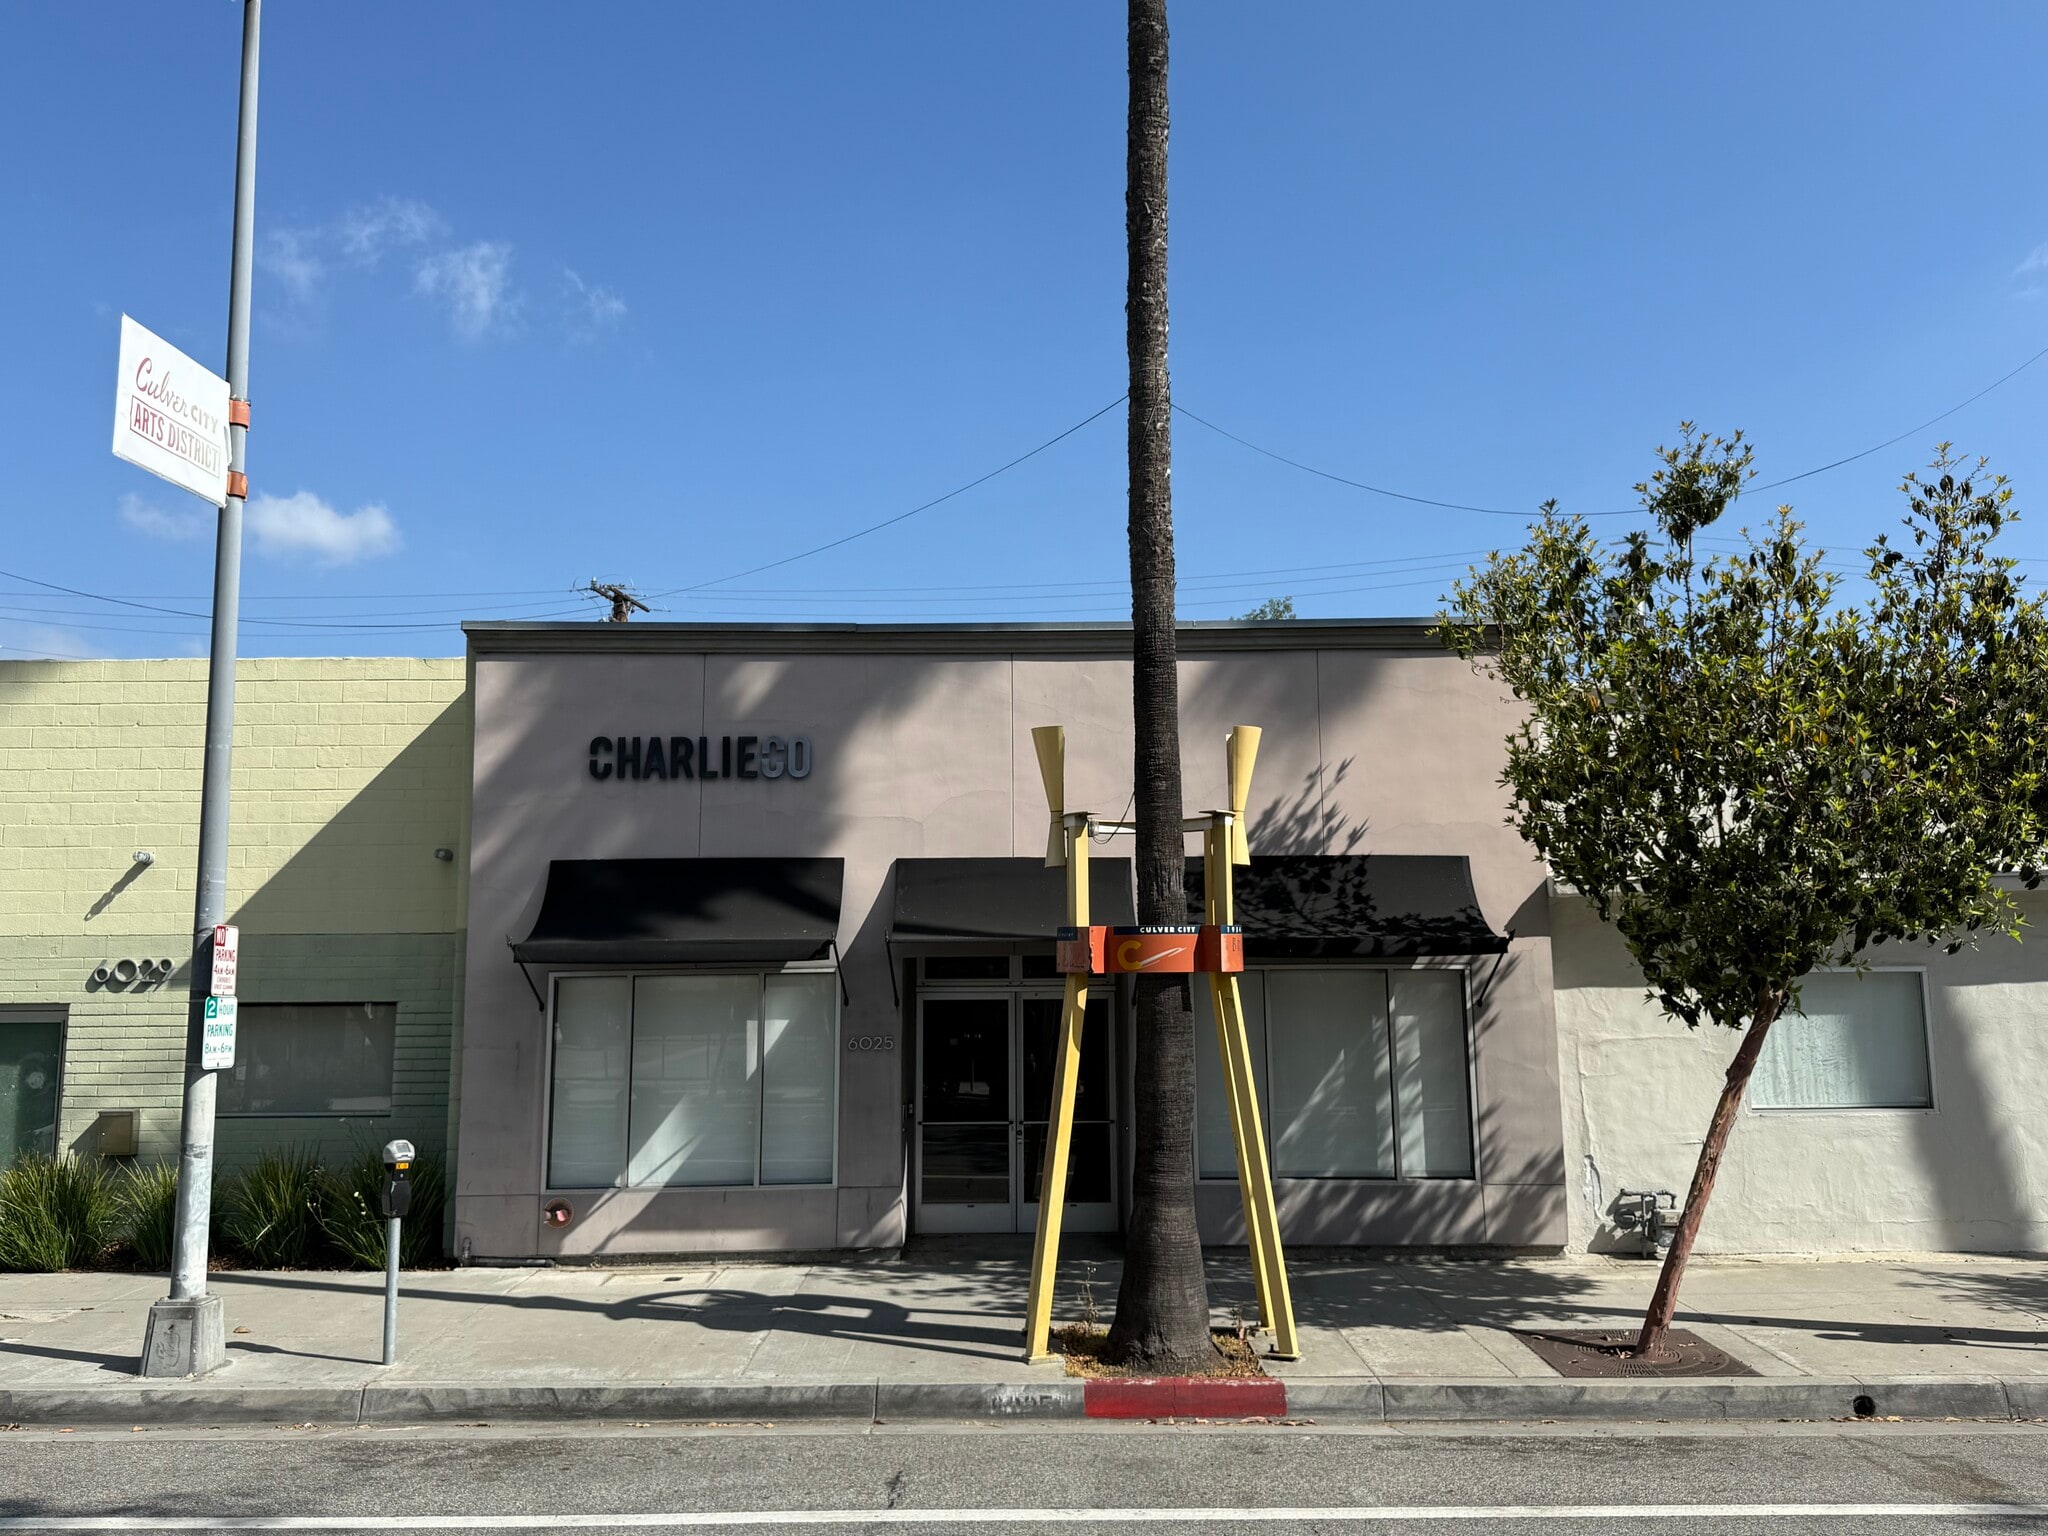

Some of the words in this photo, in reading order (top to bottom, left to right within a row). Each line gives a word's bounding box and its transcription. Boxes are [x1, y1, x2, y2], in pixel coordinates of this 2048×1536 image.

[136, 357, 188, 417] Culver
[190, 405, 219, 434] CITY
[134, 403, 165, 442] ARTS
[168, 423, 218, 472] DISTRICT
[216, 926, 226, 946] NO
[215, 948, 235, 962] PARKING
[207, 999, 217, 1016] 2
[219, 1004, 234, 1015] HOUR
[207, 1024, 233, 1037] PARKING
[848, 1036, 894, 1050] 6025
